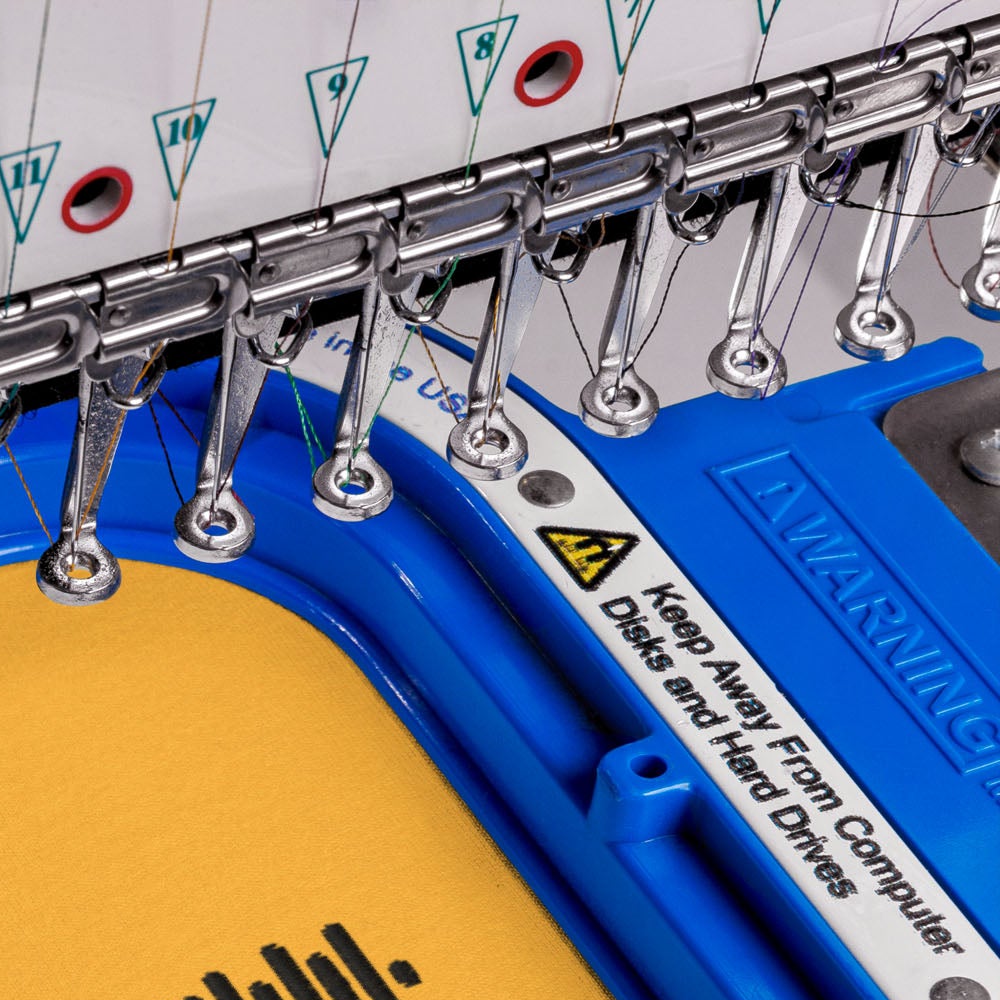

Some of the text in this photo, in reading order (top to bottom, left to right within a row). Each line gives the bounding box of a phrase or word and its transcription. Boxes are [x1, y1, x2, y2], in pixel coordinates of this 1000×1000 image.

[473, 31, 497, 61] 8
[327, 72, 348, 102] 9
[164, 112, 205, 149] 10
[9, 155, 44, 191] 11
[416, 376, 469, 420] US
[783, 510, 1000, 755] WARNING
[598, 594, 860, 901] Disks and Hard Drives
[641, 581, 967, 957] Keep Away From Computer
